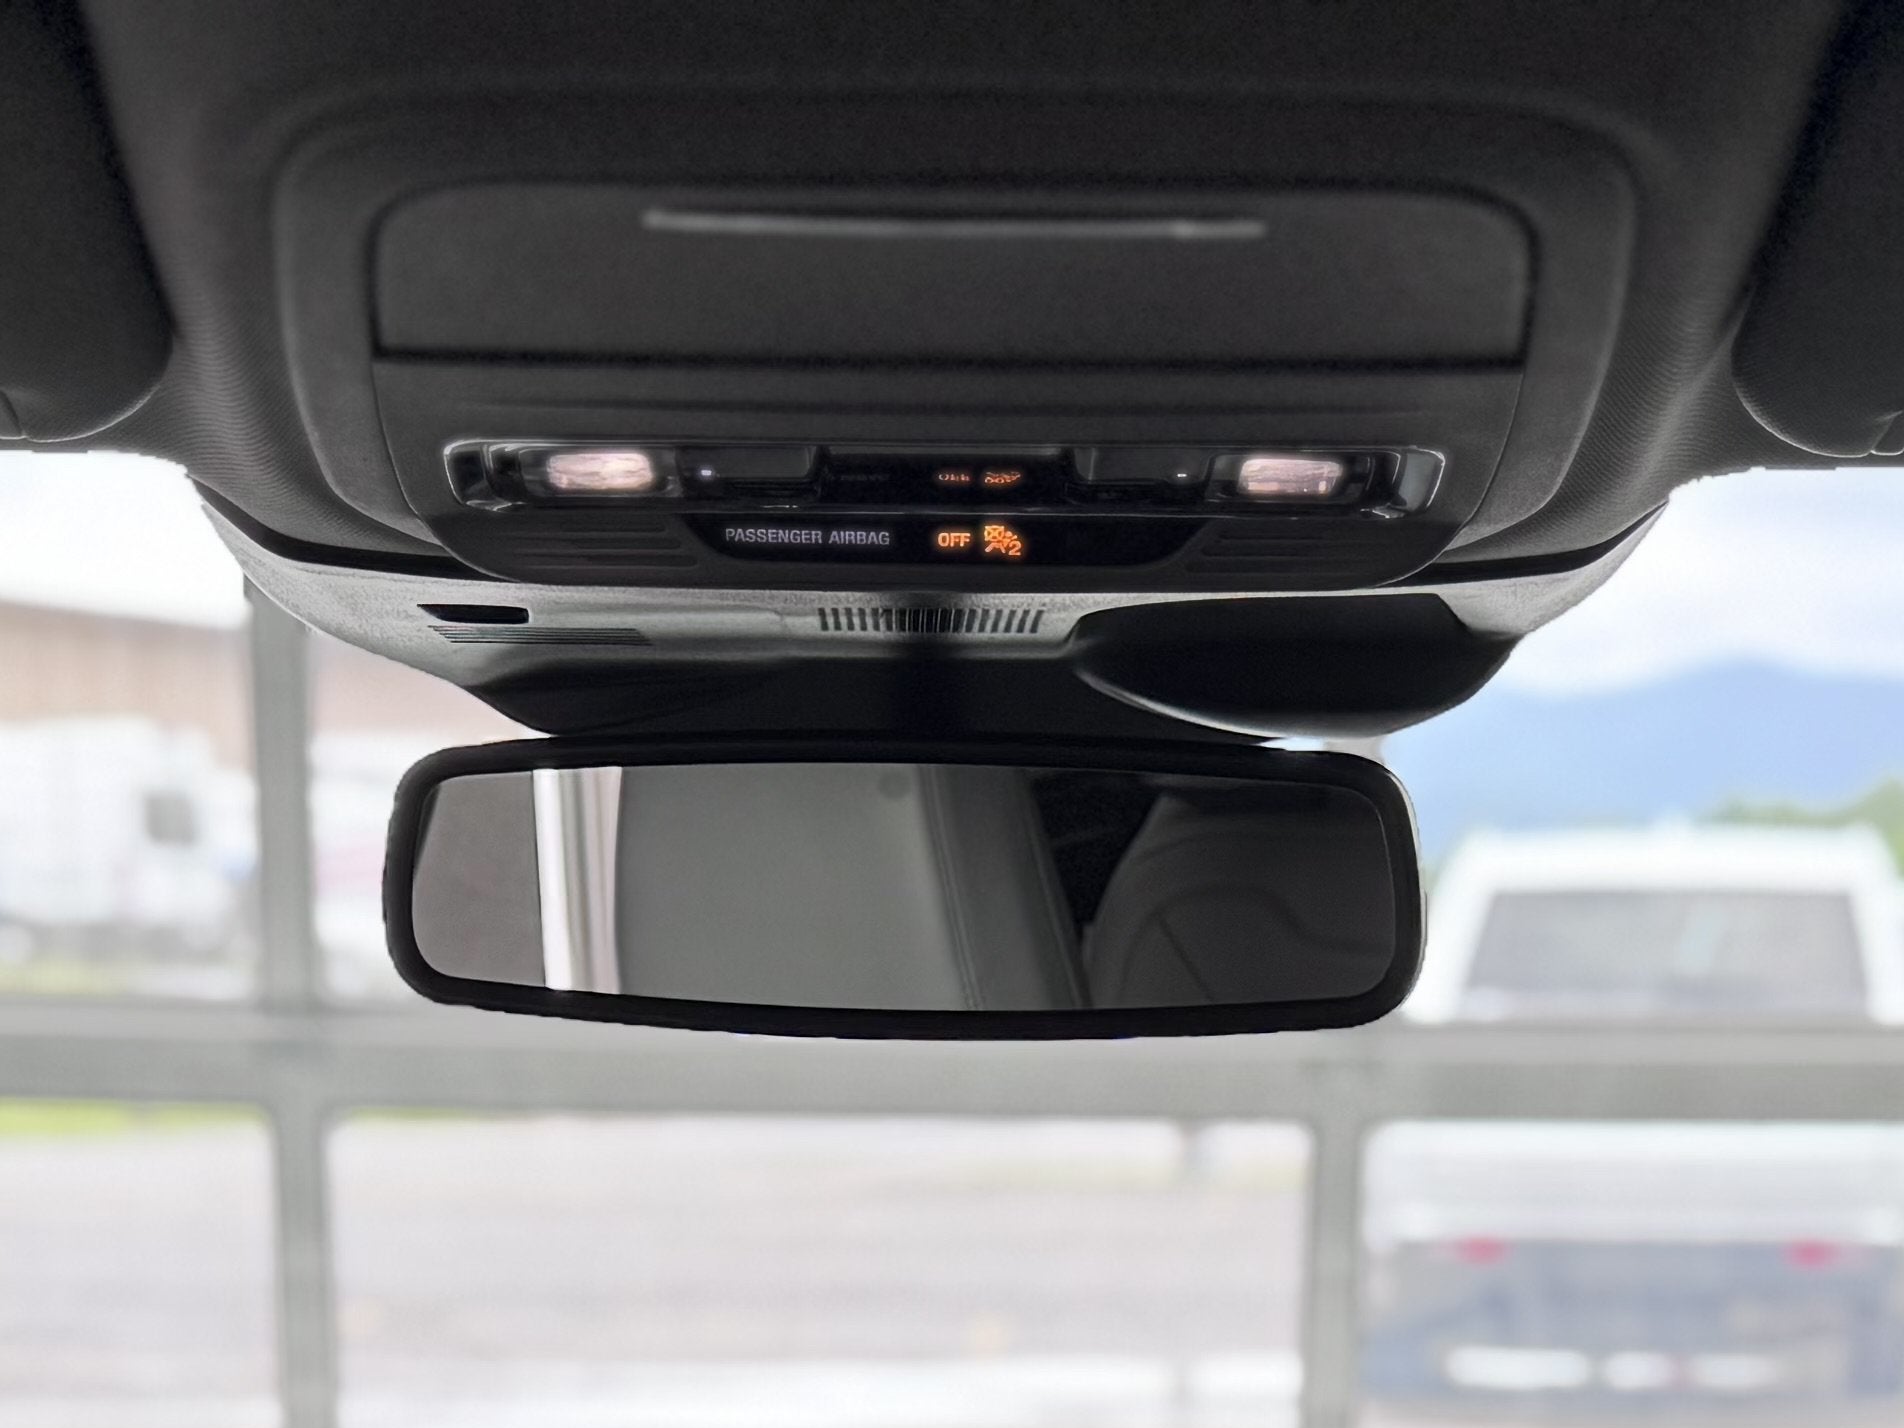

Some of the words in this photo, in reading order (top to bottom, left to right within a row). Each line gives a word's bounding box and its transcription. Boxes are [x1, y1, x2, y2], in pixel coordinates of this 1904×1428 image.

[725, 528, 823, 544] PASSENGER
[828, 530, 890, 546] AIRBAG
[937, 531, 971, 547] OFF
